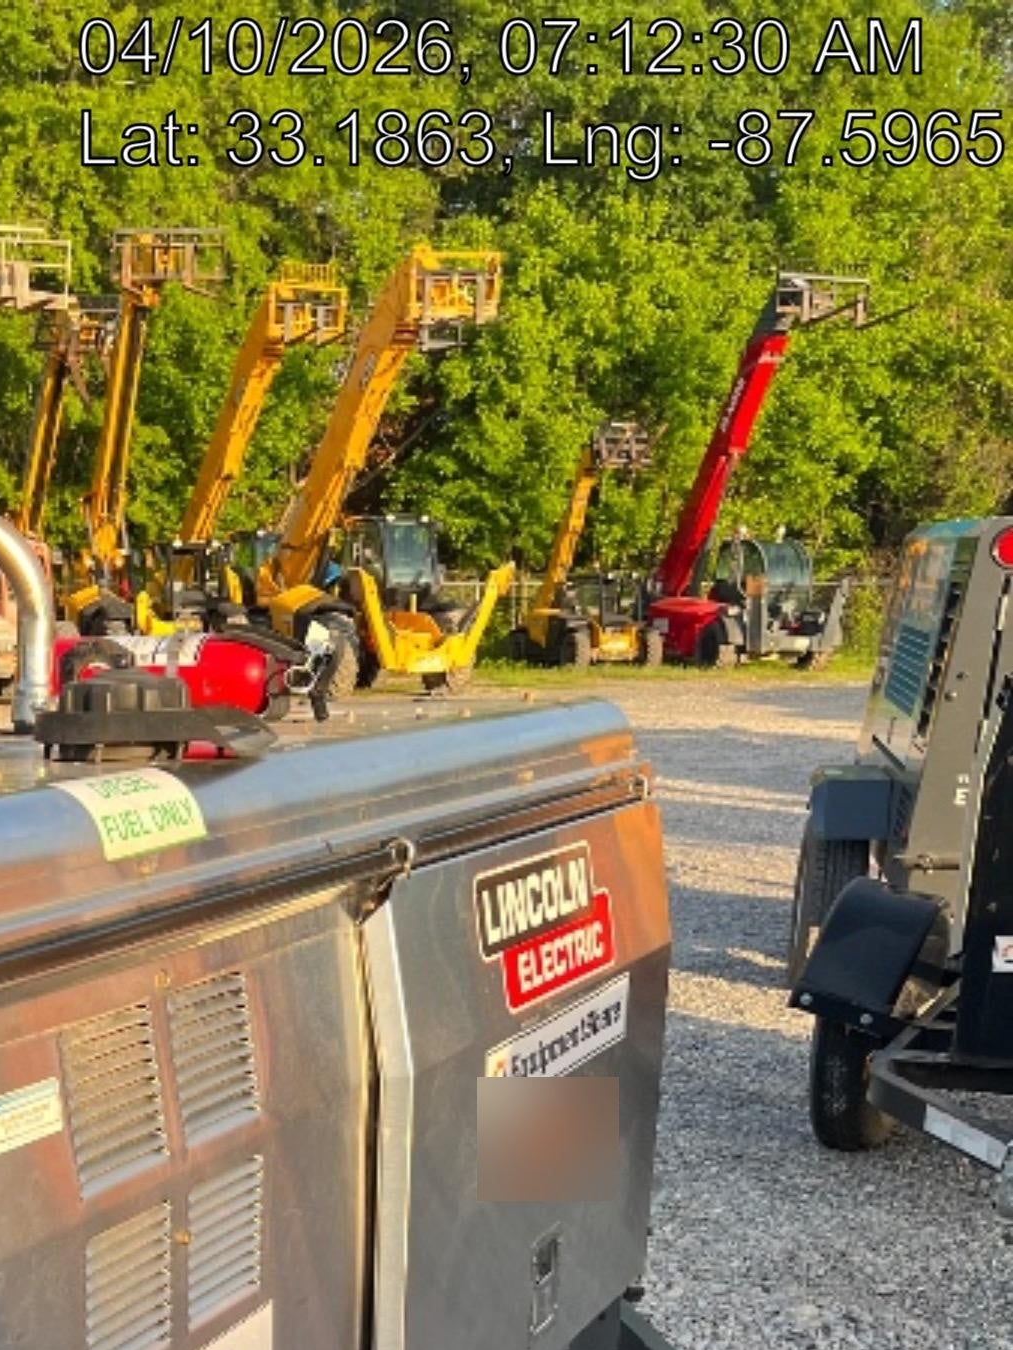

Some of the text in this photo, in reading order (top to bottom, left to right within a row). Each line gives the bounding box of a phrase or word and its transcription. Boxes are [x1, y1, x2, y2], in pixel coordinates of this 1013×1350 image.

[100, 797, 195, 843] FUEL ONLY
[481, 857, 588, 946] LINCOLN
[516, 920, 604, 994] ELECTRIC
